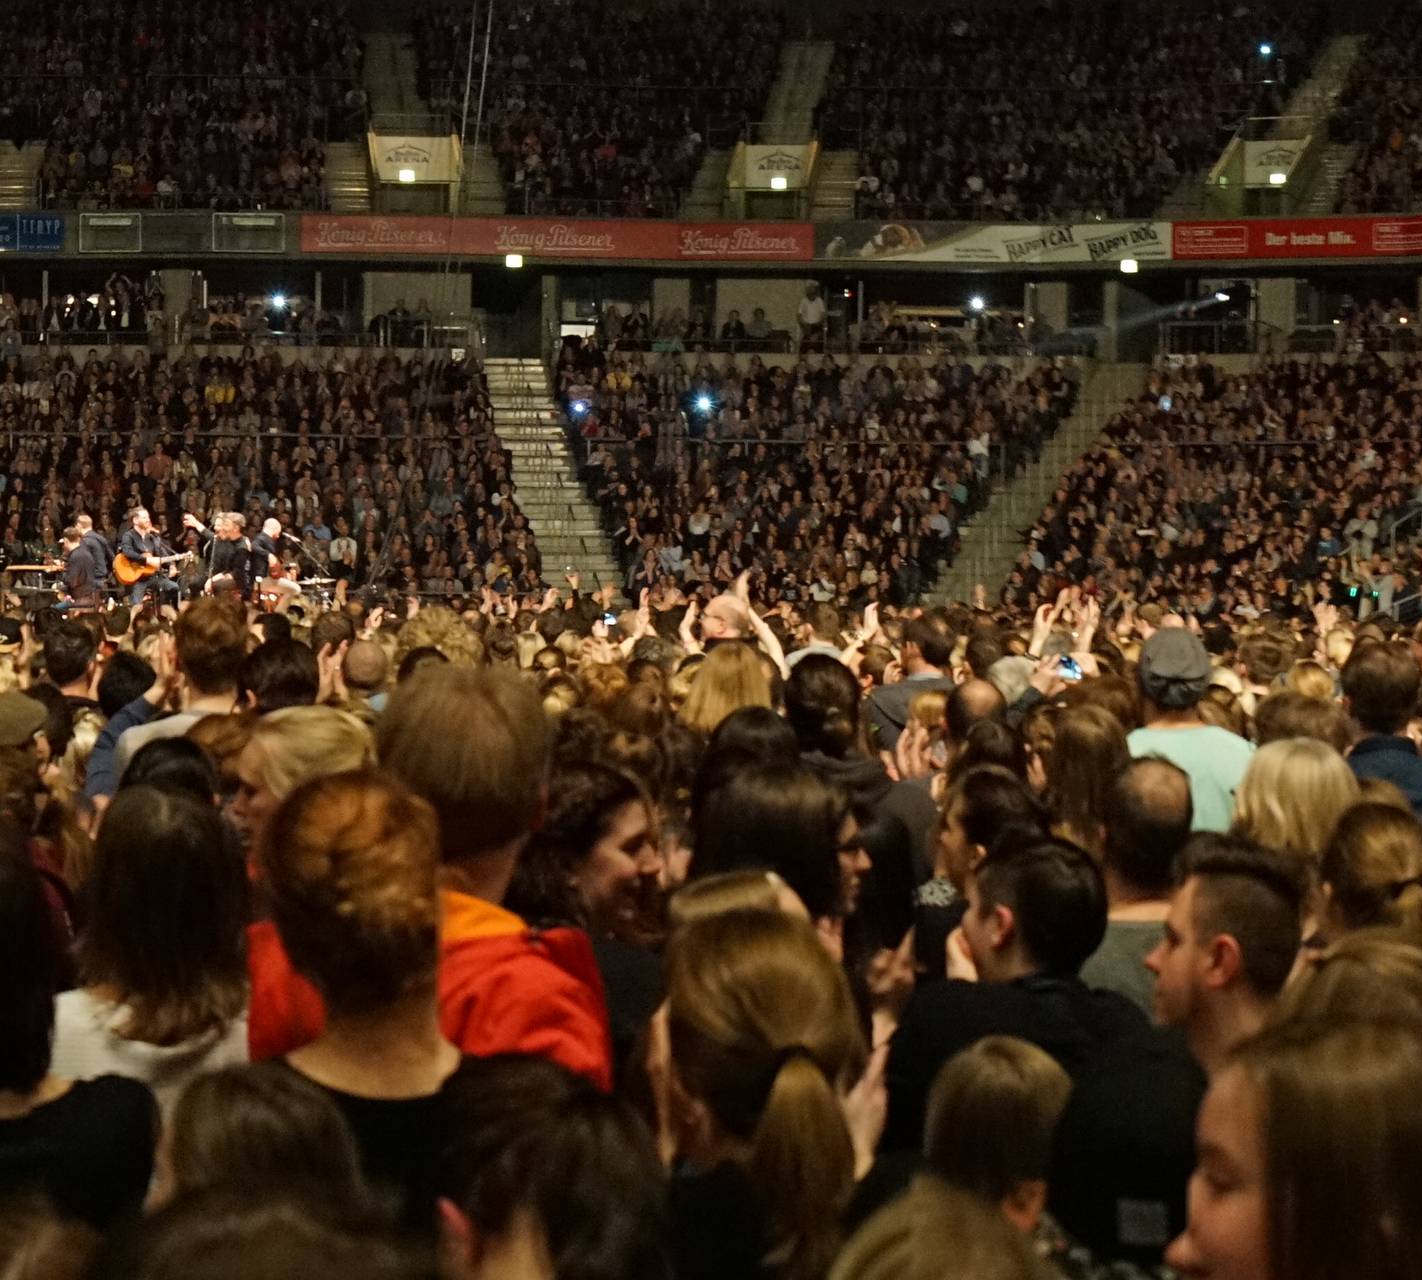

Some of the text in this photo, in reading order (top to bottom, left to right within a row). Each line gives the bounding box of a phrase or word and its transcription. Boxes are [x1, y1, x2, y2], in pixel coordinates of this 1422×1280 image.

[1006, 236, 1048, 262] HAPPY
[1050, 226, 1075, 248] CAT
[1087, 232, 1131, 262] HAPPY
